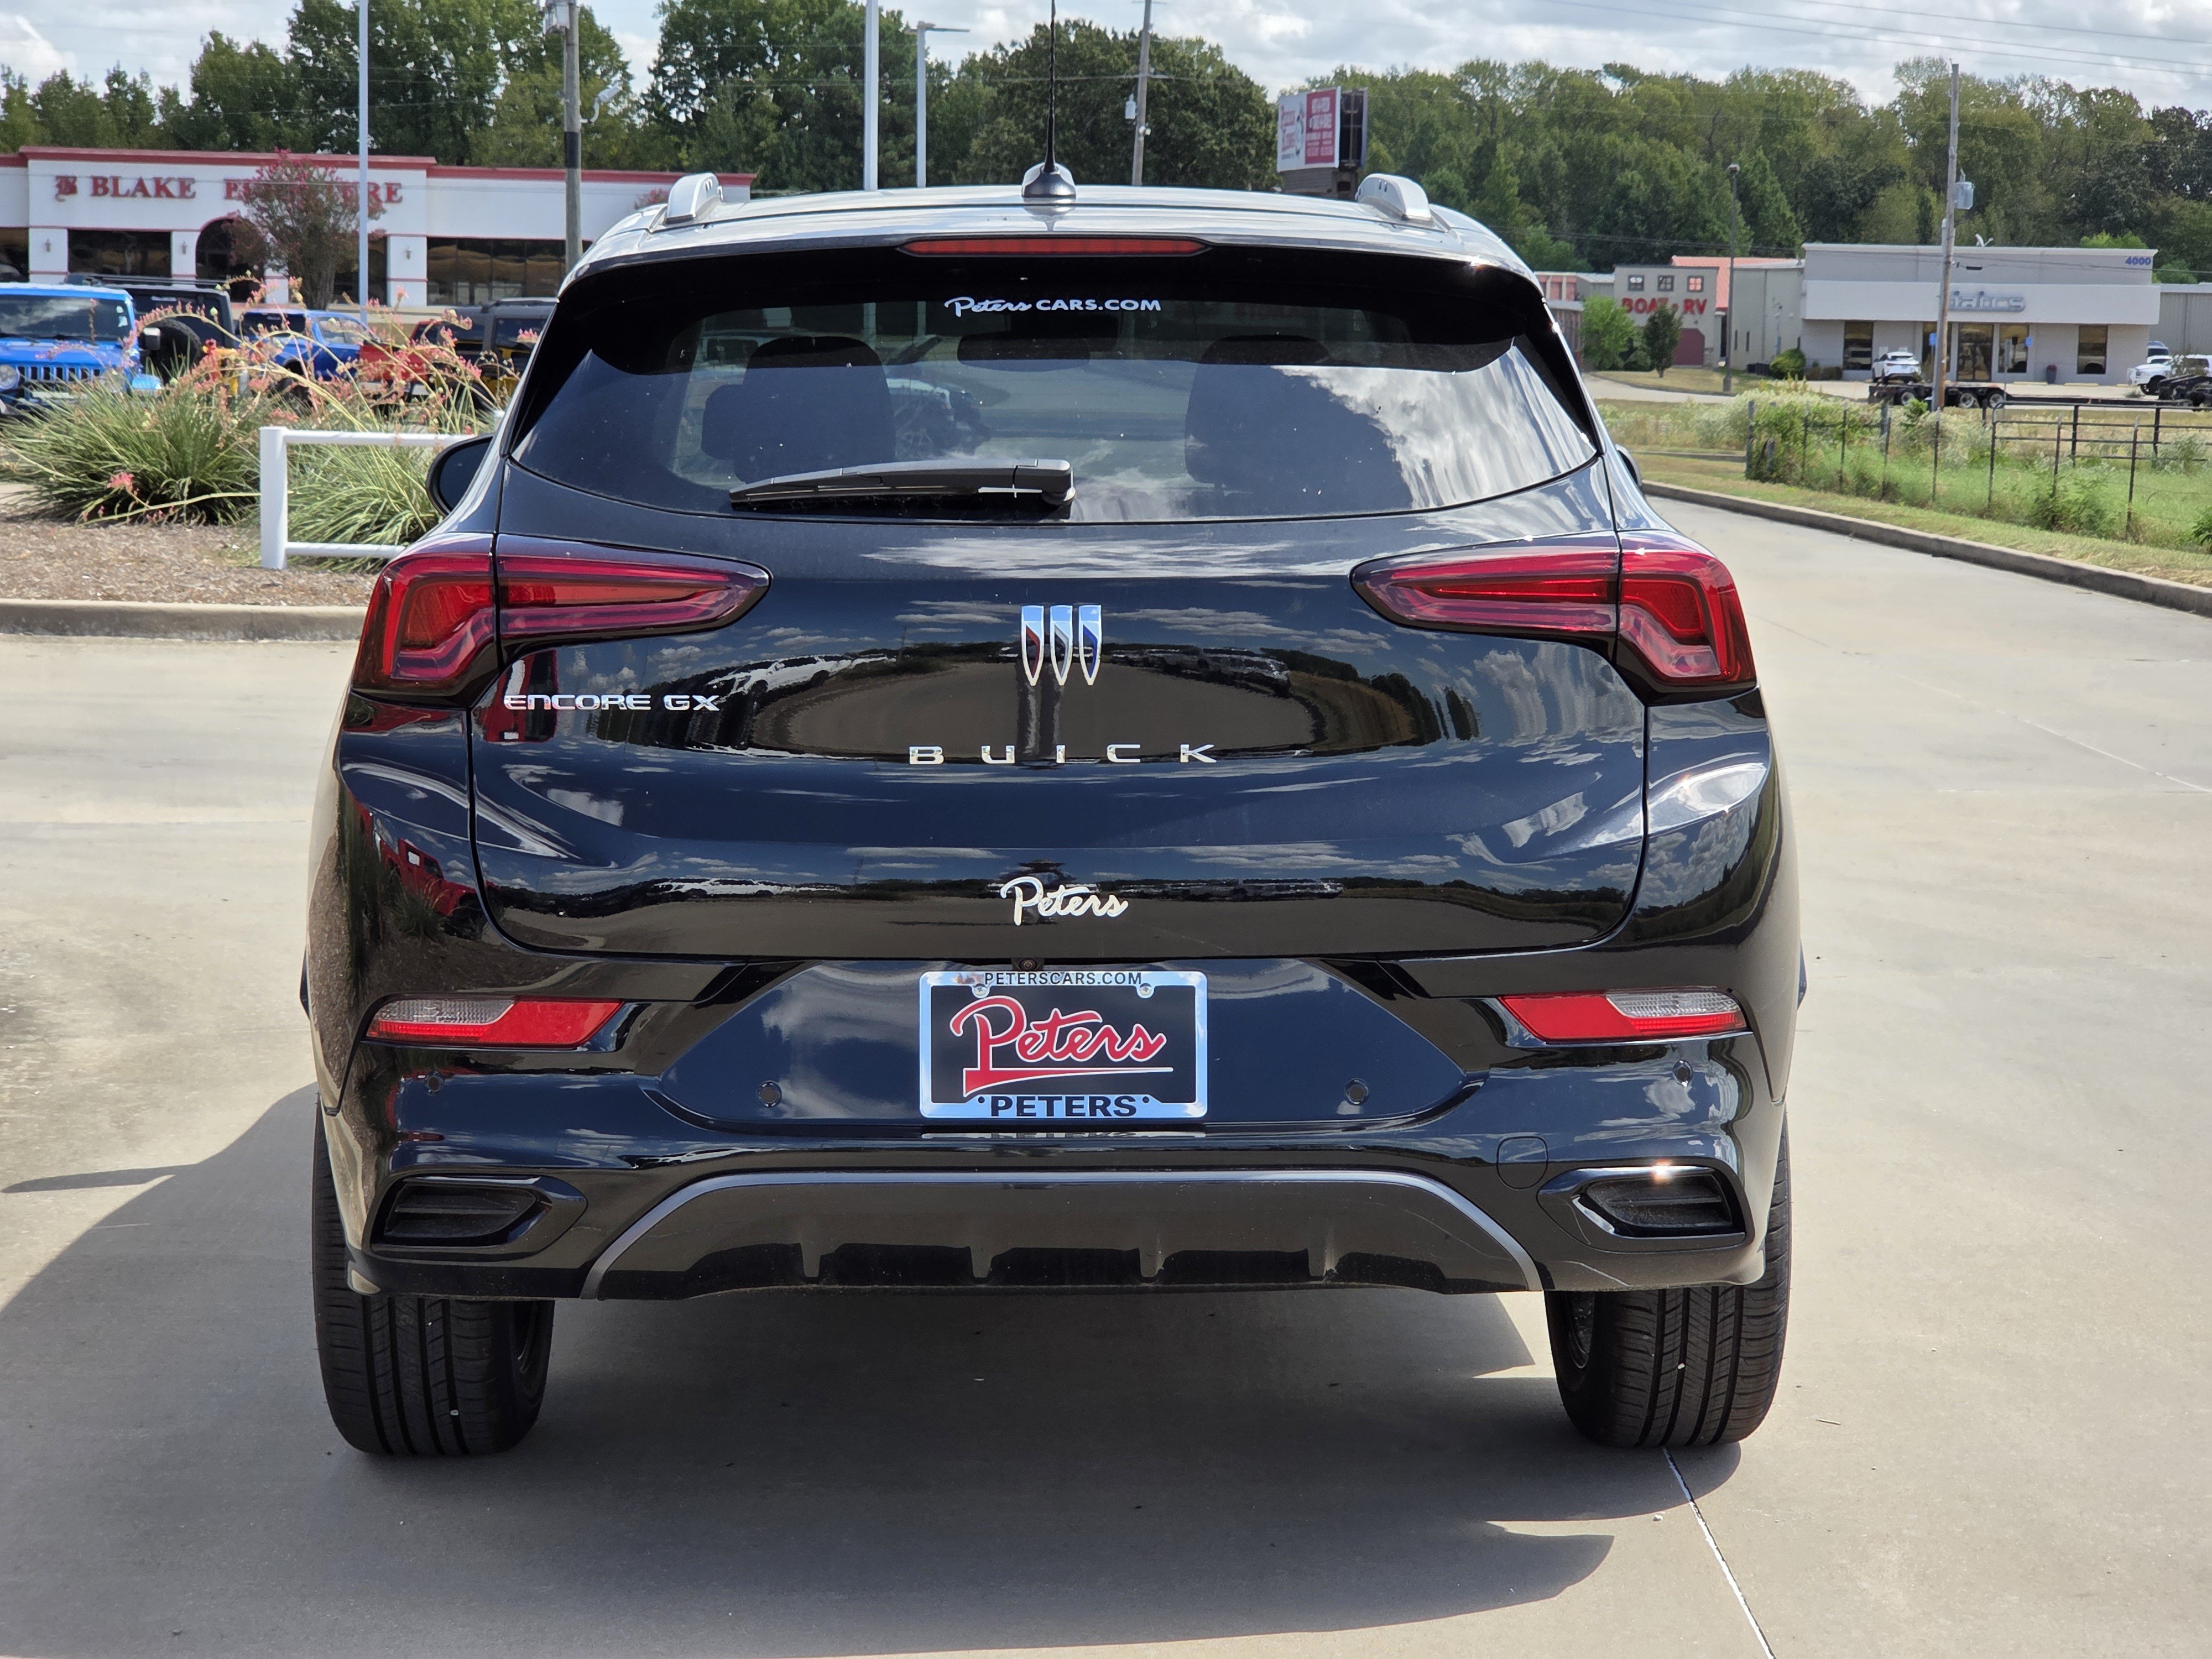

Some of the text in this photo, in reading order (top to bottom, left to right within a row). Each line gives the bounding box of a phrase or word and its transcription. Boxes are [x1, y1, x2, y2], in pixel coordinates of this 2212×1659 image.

[90, 175, 196, 199] BLAKE
[2125, 257, 2151, 265] 4000
[1683, 298, 1708, 315] RV
[504, 695, 720, 711] ENCORE GX
[909, 744, 1217, 764] BUICK
[1000, 876, 1129, 926] Peters
[984, 972, 1142, 985] PETERSCARS.COM
[950, 995, 1167, 1073] Peters
[990, 1095, 1137, 1117] PETERS
